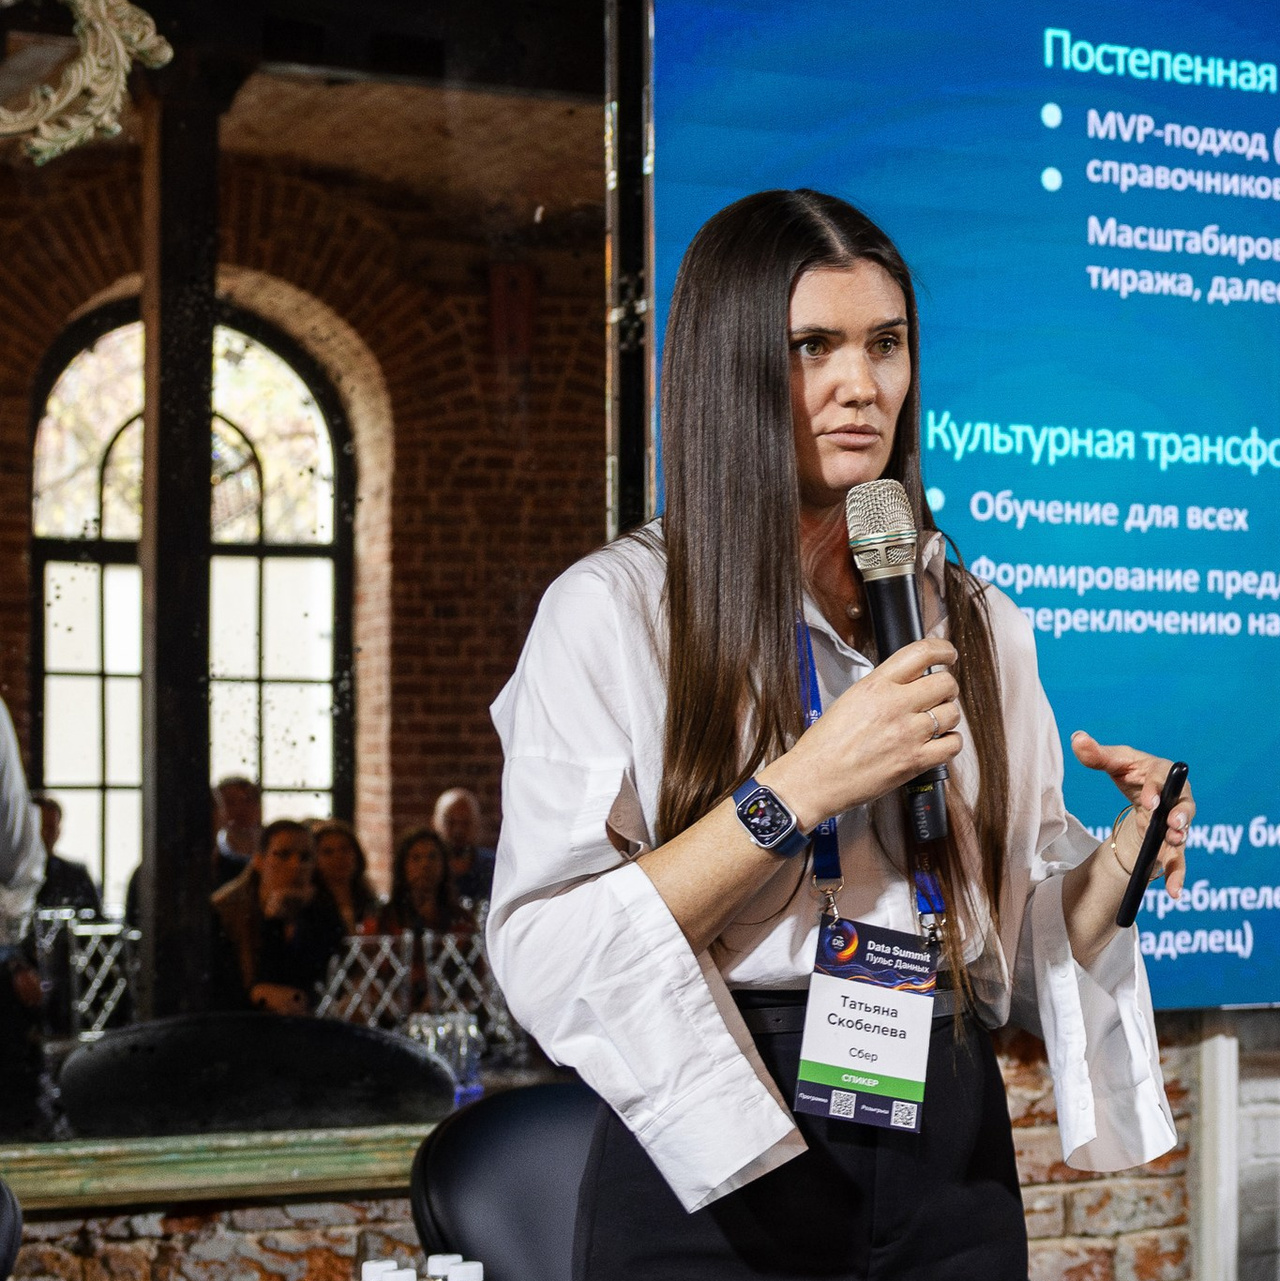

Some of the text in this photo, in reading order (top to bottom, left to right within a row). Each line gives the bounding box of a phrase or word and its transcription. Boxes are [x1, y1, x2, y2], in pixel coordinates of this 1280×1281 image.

[1044, 29, 1278, 94] Постепенная
[1086, 109, 1269, 162] MVP-подход
[1087, 263, 1201, 302] тиража,
[927, 410, 1135, 465] Культурная
[969, 490, 1248, 532] Обучение для всех
[971, 555, 1199, 596] Формирование
[1248, 612, 1280, 636] на
[1188, 822, 1243, 855] жду
[867, 940, 931, 962] Data Summit
[1140, 921, 1253, 959] аделец)
[865, 953, 929, 974] Пульс Данных
[840, 995, 899, 1018] Татьяна
[827, 1013, 907, 1039] Скобелева
[849, 1047, 878, 1063] Сбер
[841, 1074, 879, 1087] СПИКЕР
